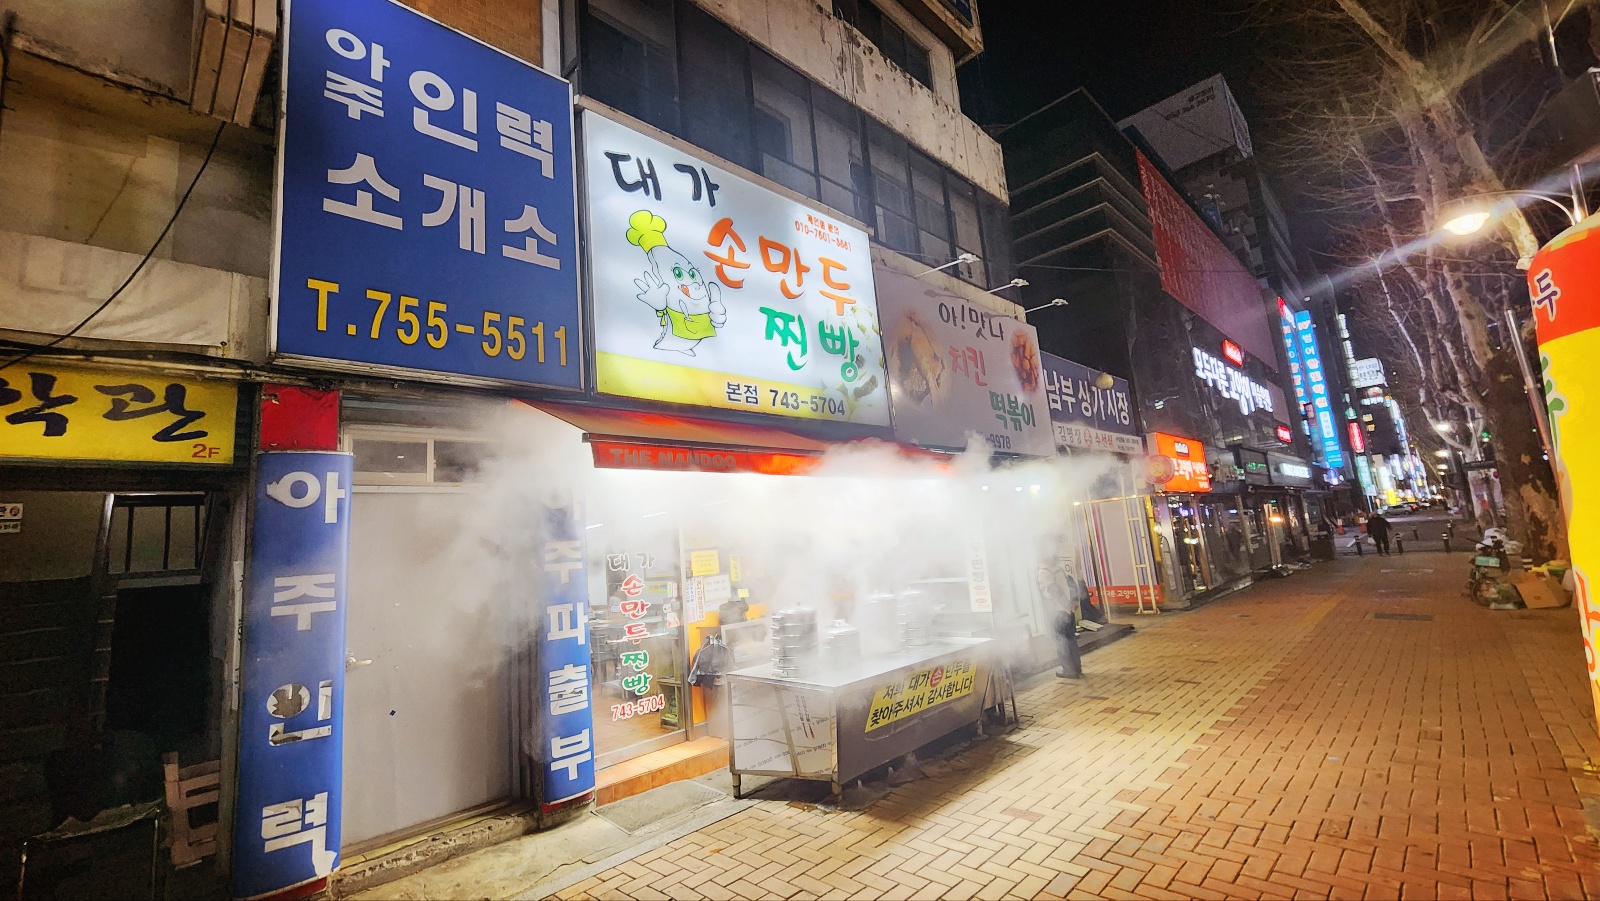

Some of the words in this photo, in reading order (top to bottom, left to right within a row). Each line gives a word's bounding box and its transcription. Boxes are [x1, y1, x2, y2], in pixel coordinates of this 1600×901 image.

[323, 28, 390, 120] 아주
[407, 69, 555, 179] 인력
[322, 151, 561, 271] 소개소
[703, 217, 858, 316] 손만두
[307, 278, 568, 367] T.755-5511
[759, 306, 860, 383] 찐빵
[949, 345, 987, 386] 치킨
[725, 380, 760, 406] 본점
[769, 389, 847, 417] 743-5704
[989, 391, 1036, 432] 떡볶이
[192, 443, 221, 459] 2F
[609, 448, 652, 466] THE
[608, 553, 657, 571] 대가
[260, 470, 346, 878] 아주인력
[620, 651, 652, 695] 찐빵
[611, 694, 665, 721] 743-5704
[870, 693, 925, 727] 찾아주셔서
[927, 676, 973, 705] 감사합니다
